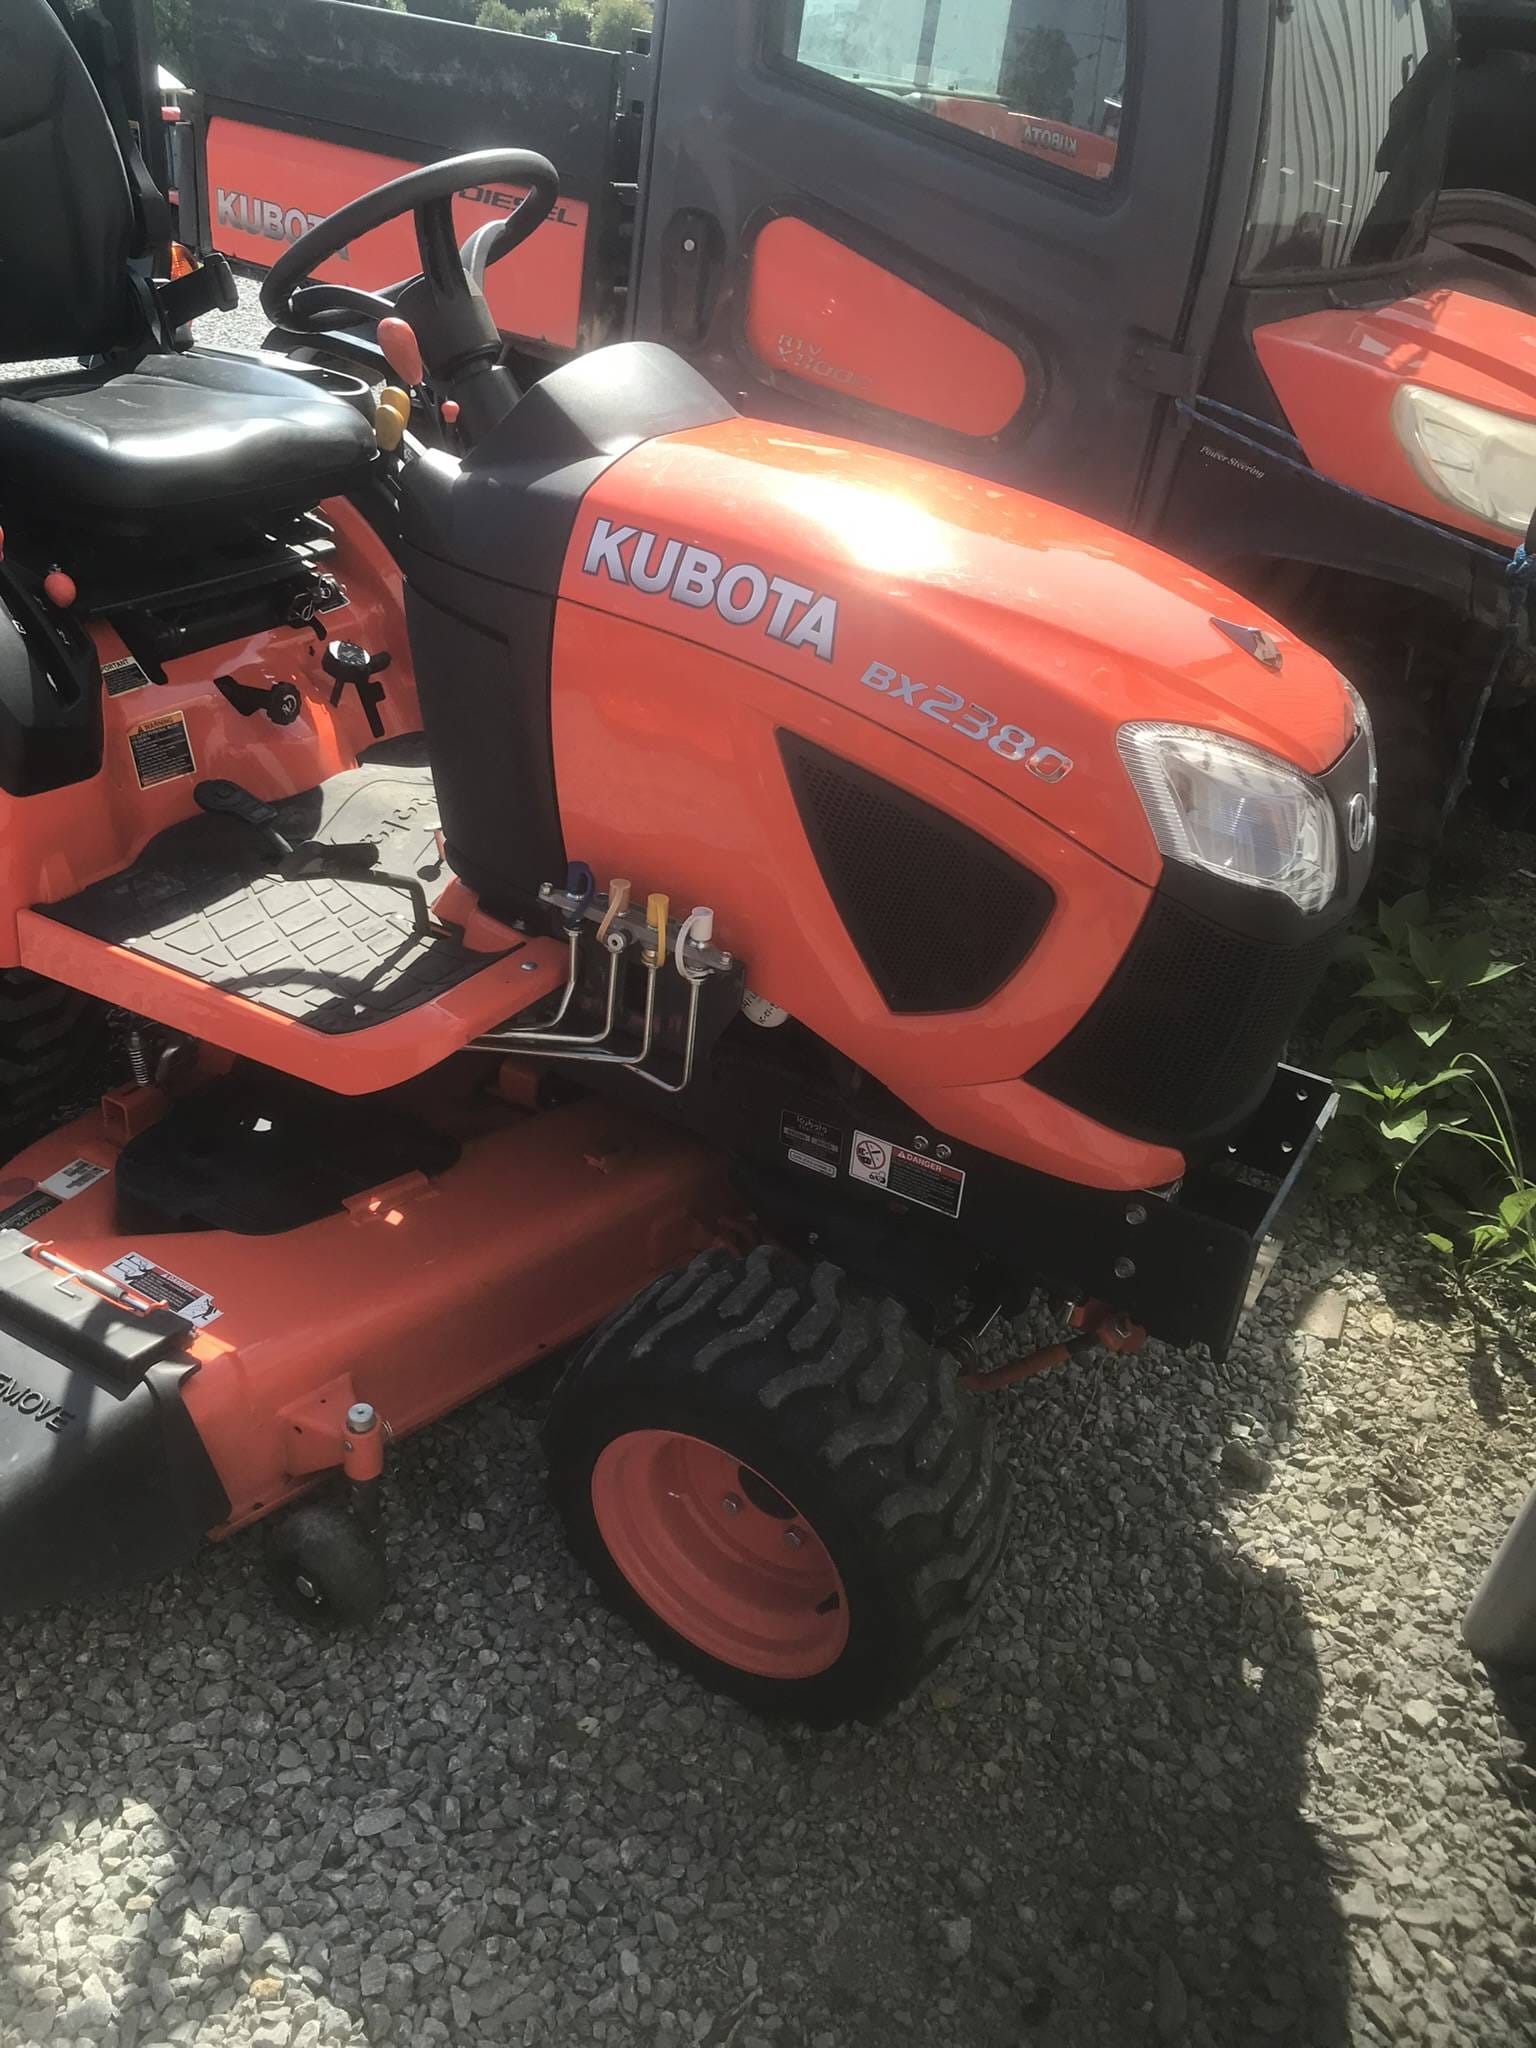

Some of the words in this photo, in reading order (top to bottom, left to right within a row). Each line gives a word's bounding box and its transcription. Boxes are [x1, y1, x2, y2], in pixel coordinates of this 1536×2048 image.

[582, 517, 839, 663] KUBOTA
[860, 661, 1073, 784] BX2380
[906, 1154, 942, 1173] DANGER
[0, 1371, 76, 1433] EMOVE
